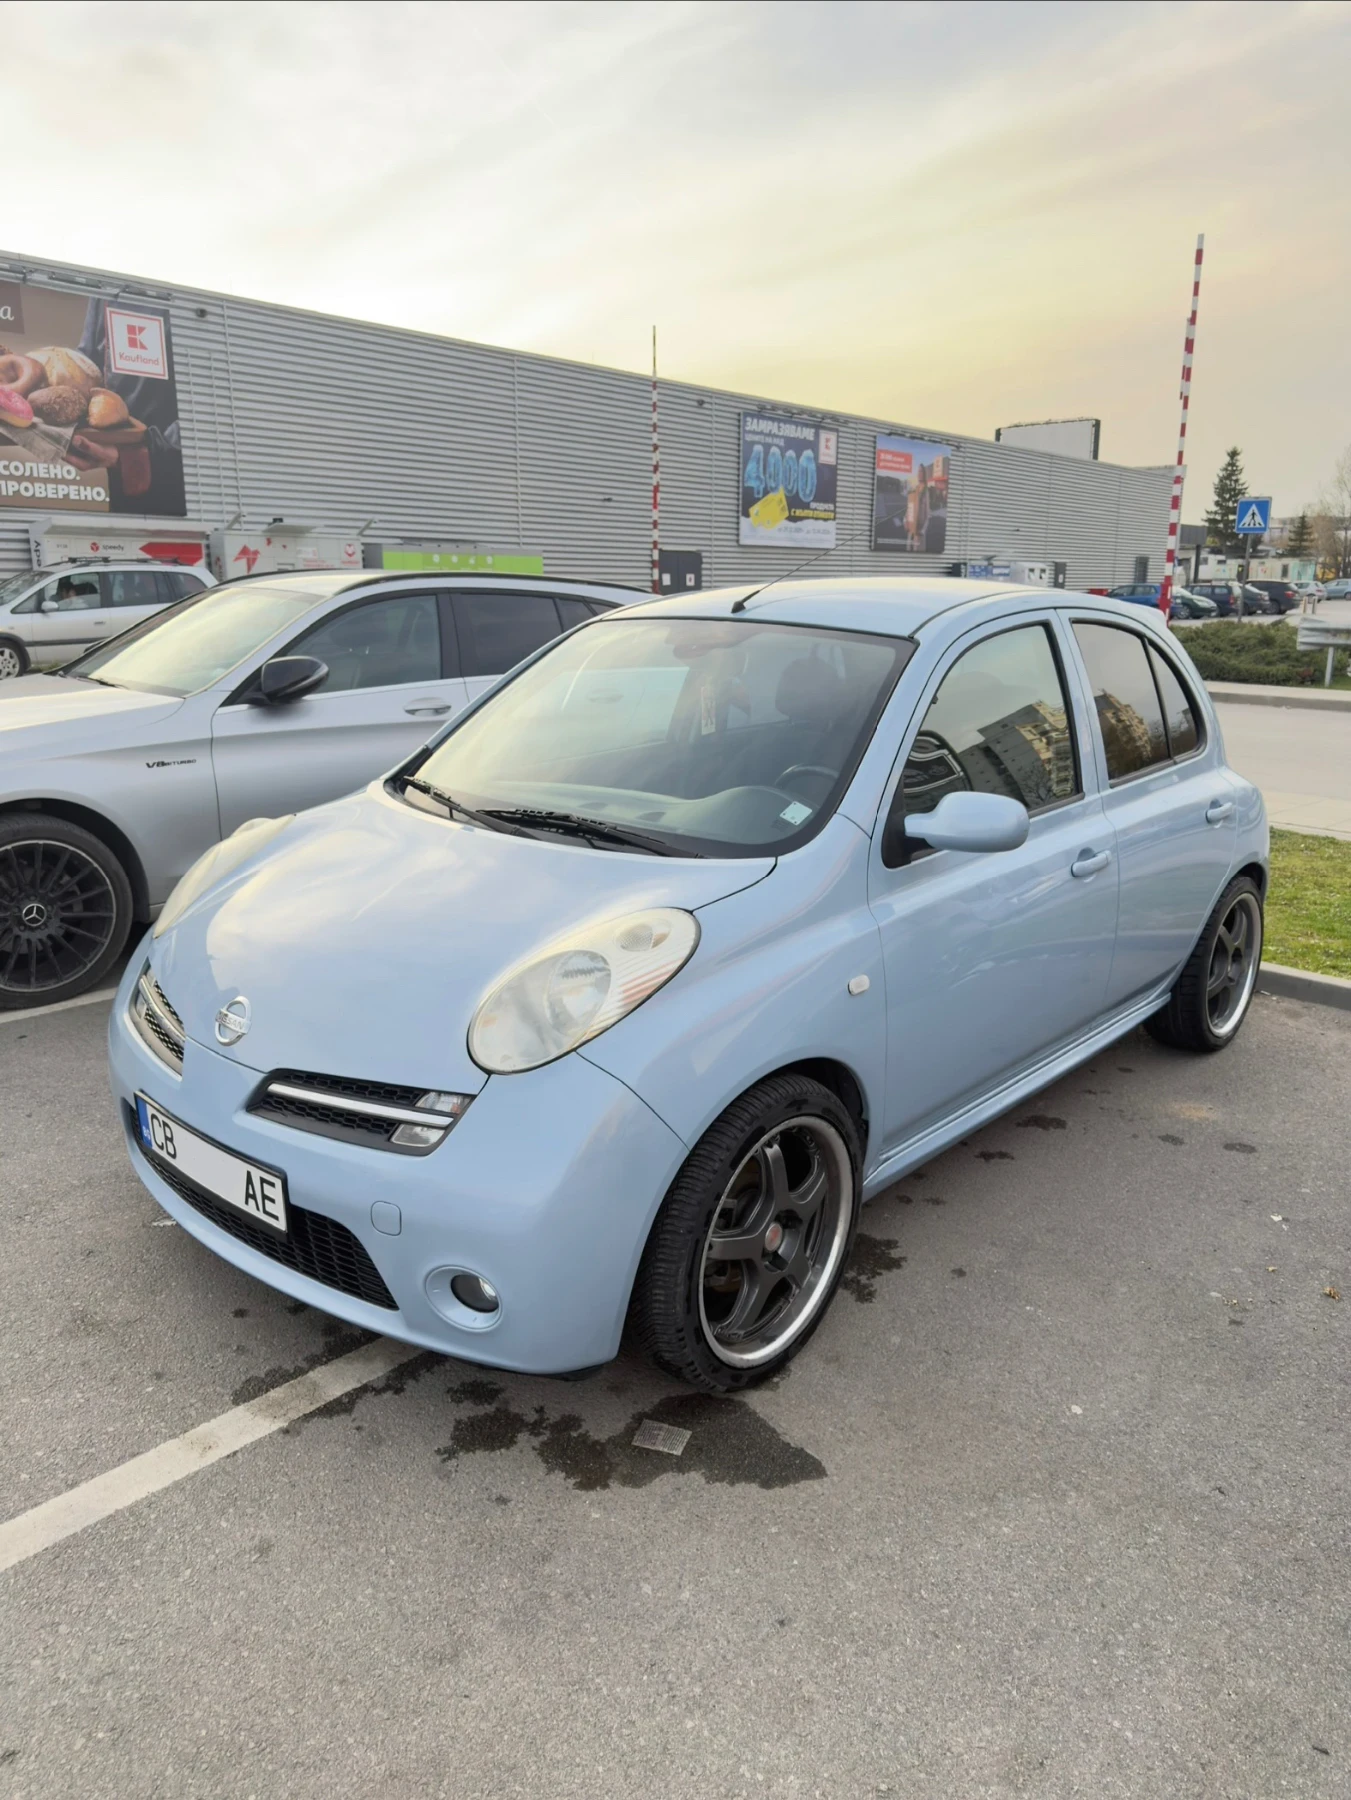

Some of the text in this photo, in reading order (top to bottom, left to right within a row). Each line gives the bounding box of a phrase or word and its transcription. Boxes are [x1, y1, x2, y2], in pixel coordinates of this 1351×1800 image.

[118, 350, 160, 366] Kaufland
[744, 416, 816, 441] ЗАМРАЗЯВАМЕ
[0, 460, 80, 480] СОЛЕНО.
[744, 444, 817, 503] 4000
[102, 544, 124, 552] speedy
[142, 1113, 280, 1222] BG CB AE
